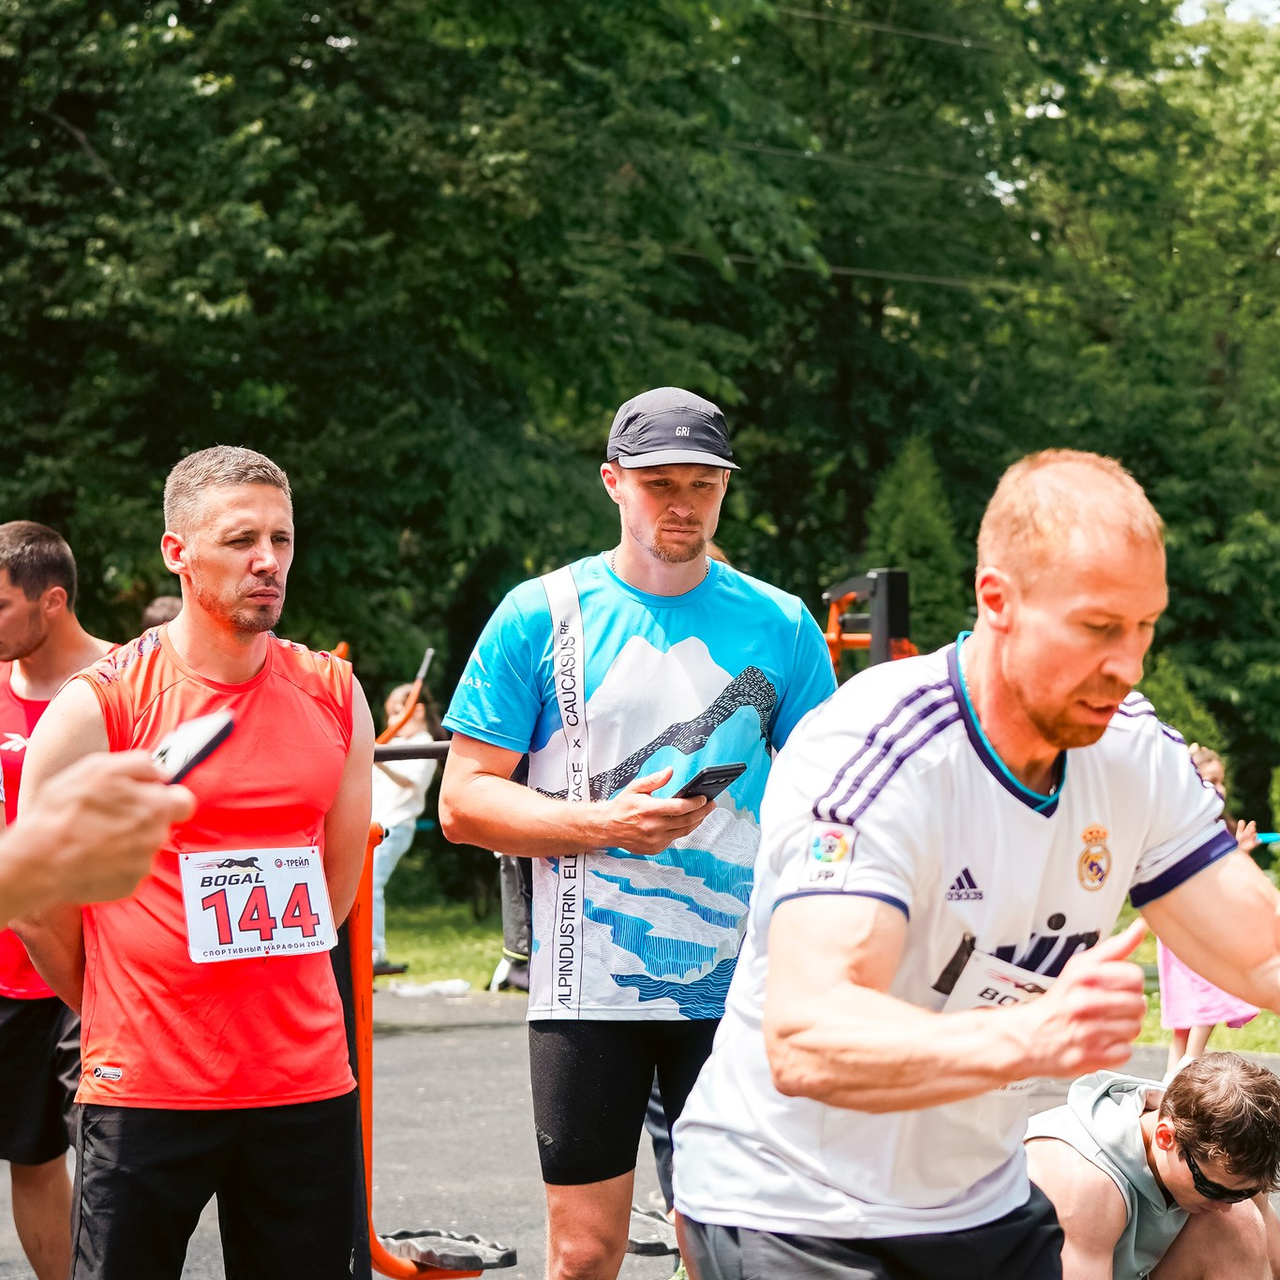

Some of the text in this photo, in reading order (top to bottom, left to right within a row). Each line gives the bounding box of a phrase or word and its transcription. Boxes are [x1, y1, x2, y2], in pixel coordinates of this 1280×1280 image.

[560, 620, 570, 635] RF
[561, 636, 579, 727] CAUCASUS
[200, 873, 264, 888] BOGAL
[201, 882, 320, 945] 144
[203, 945, 262, 957] СПОРТИВНЫЙ
[264, 942, 305, 952] МАРАФОН
